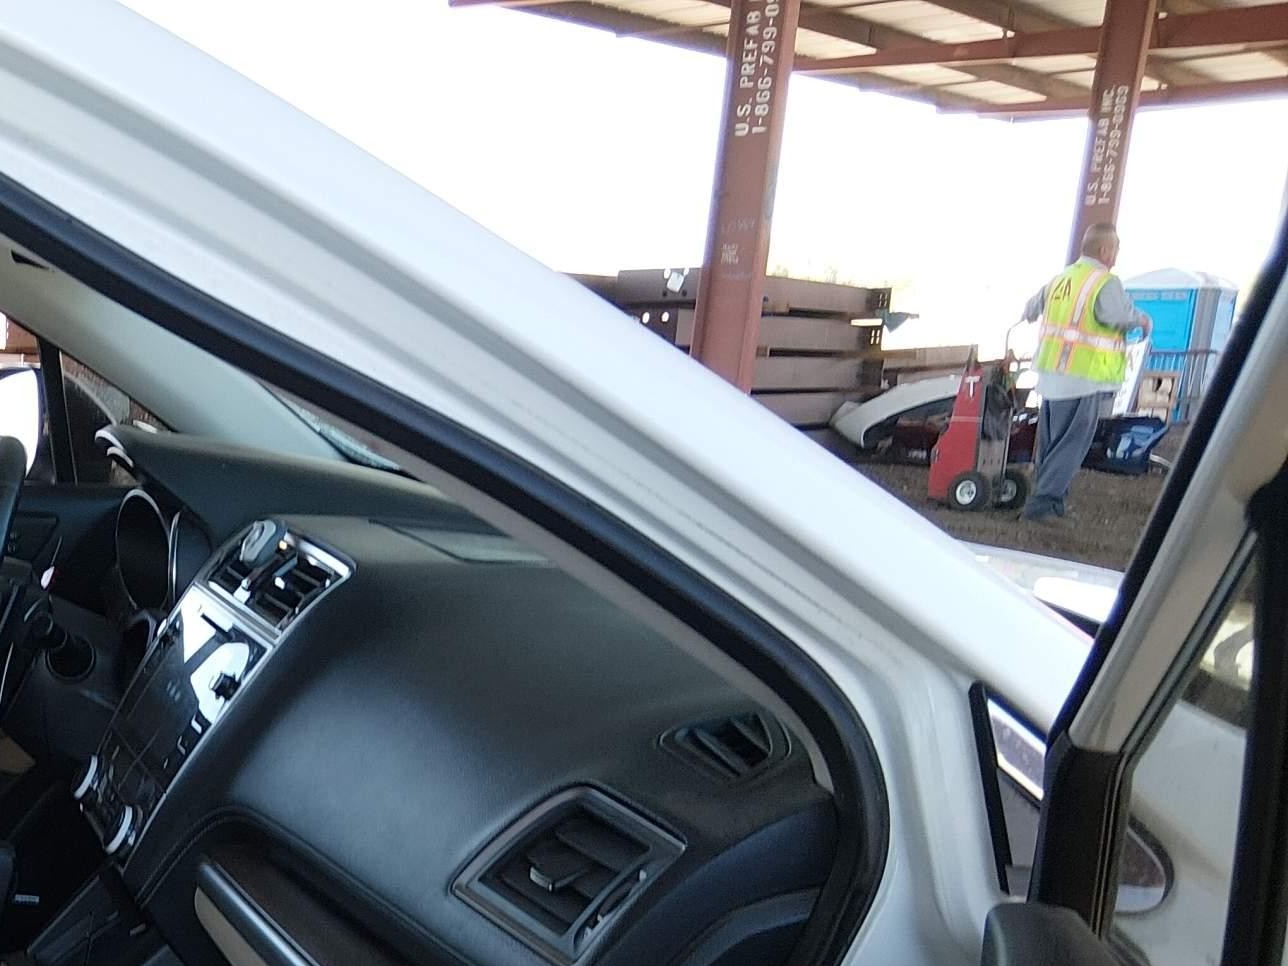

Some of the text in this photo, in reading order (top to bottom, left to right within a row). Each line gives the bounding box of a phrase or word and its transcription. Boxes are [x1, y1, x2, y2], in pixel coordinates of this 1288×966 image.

[734, 10, 761, 136] U.S. PREFAB
[752, 0, 780, 134] 1-866-799-0
[1091, 119, 1109, 172] PREFAB
